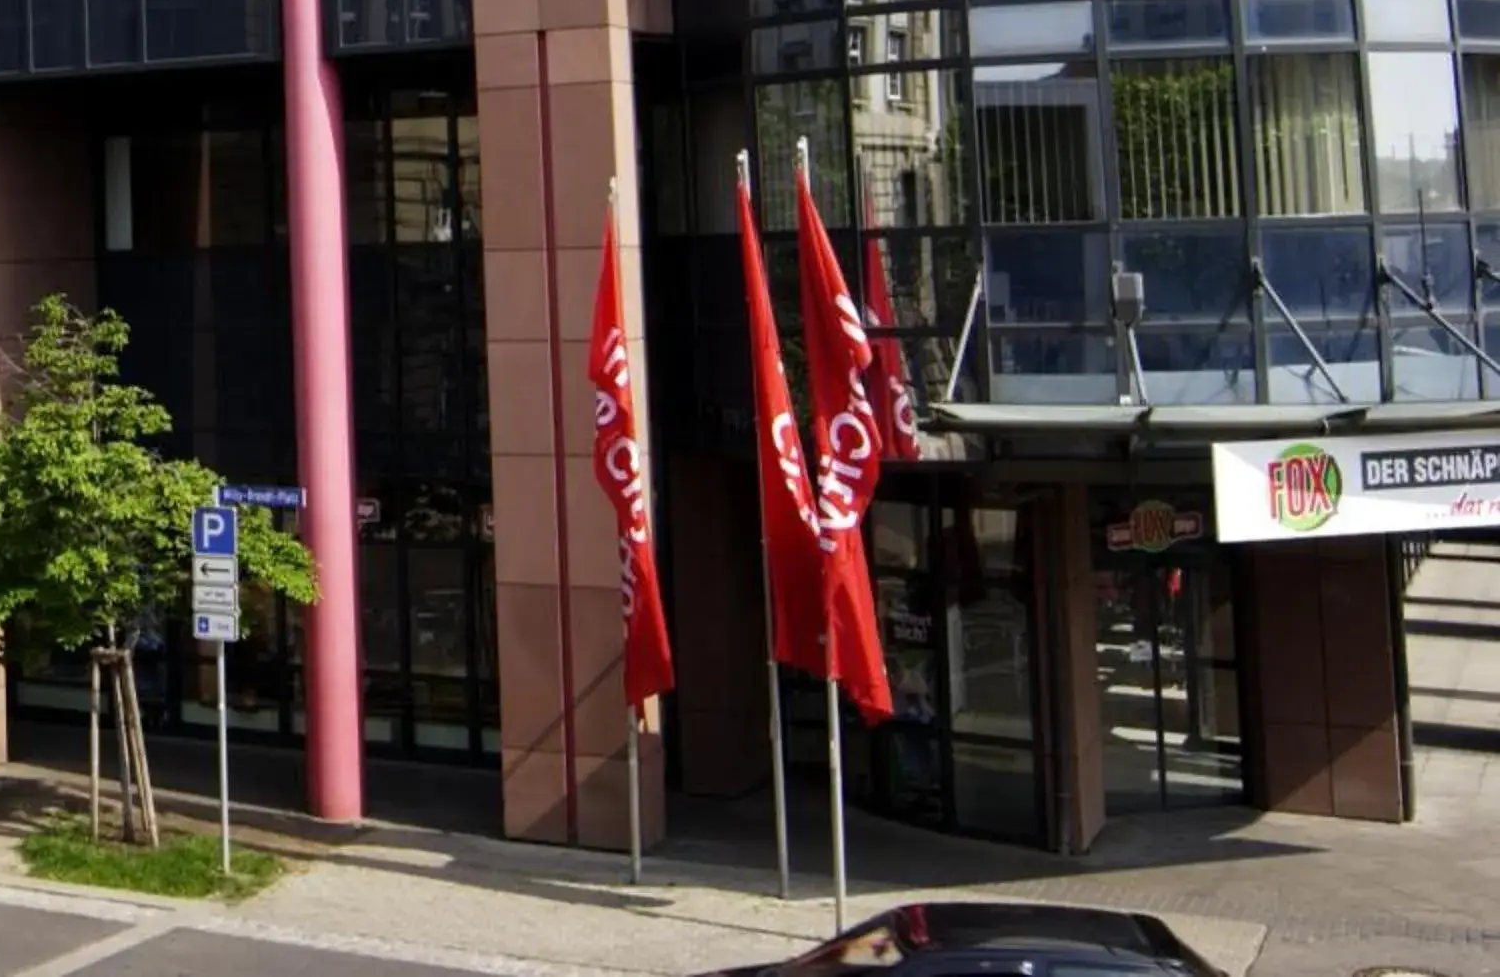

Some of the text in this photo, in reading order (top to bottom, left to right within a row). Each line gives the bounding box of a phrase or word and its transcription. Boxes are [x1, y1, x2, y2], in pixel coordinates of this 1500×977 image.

[1366, 448, 1500, 486] DER SCHNÄP
[1266, 453, 1332, 520] FOX
[203, 514, 225, 549] P
